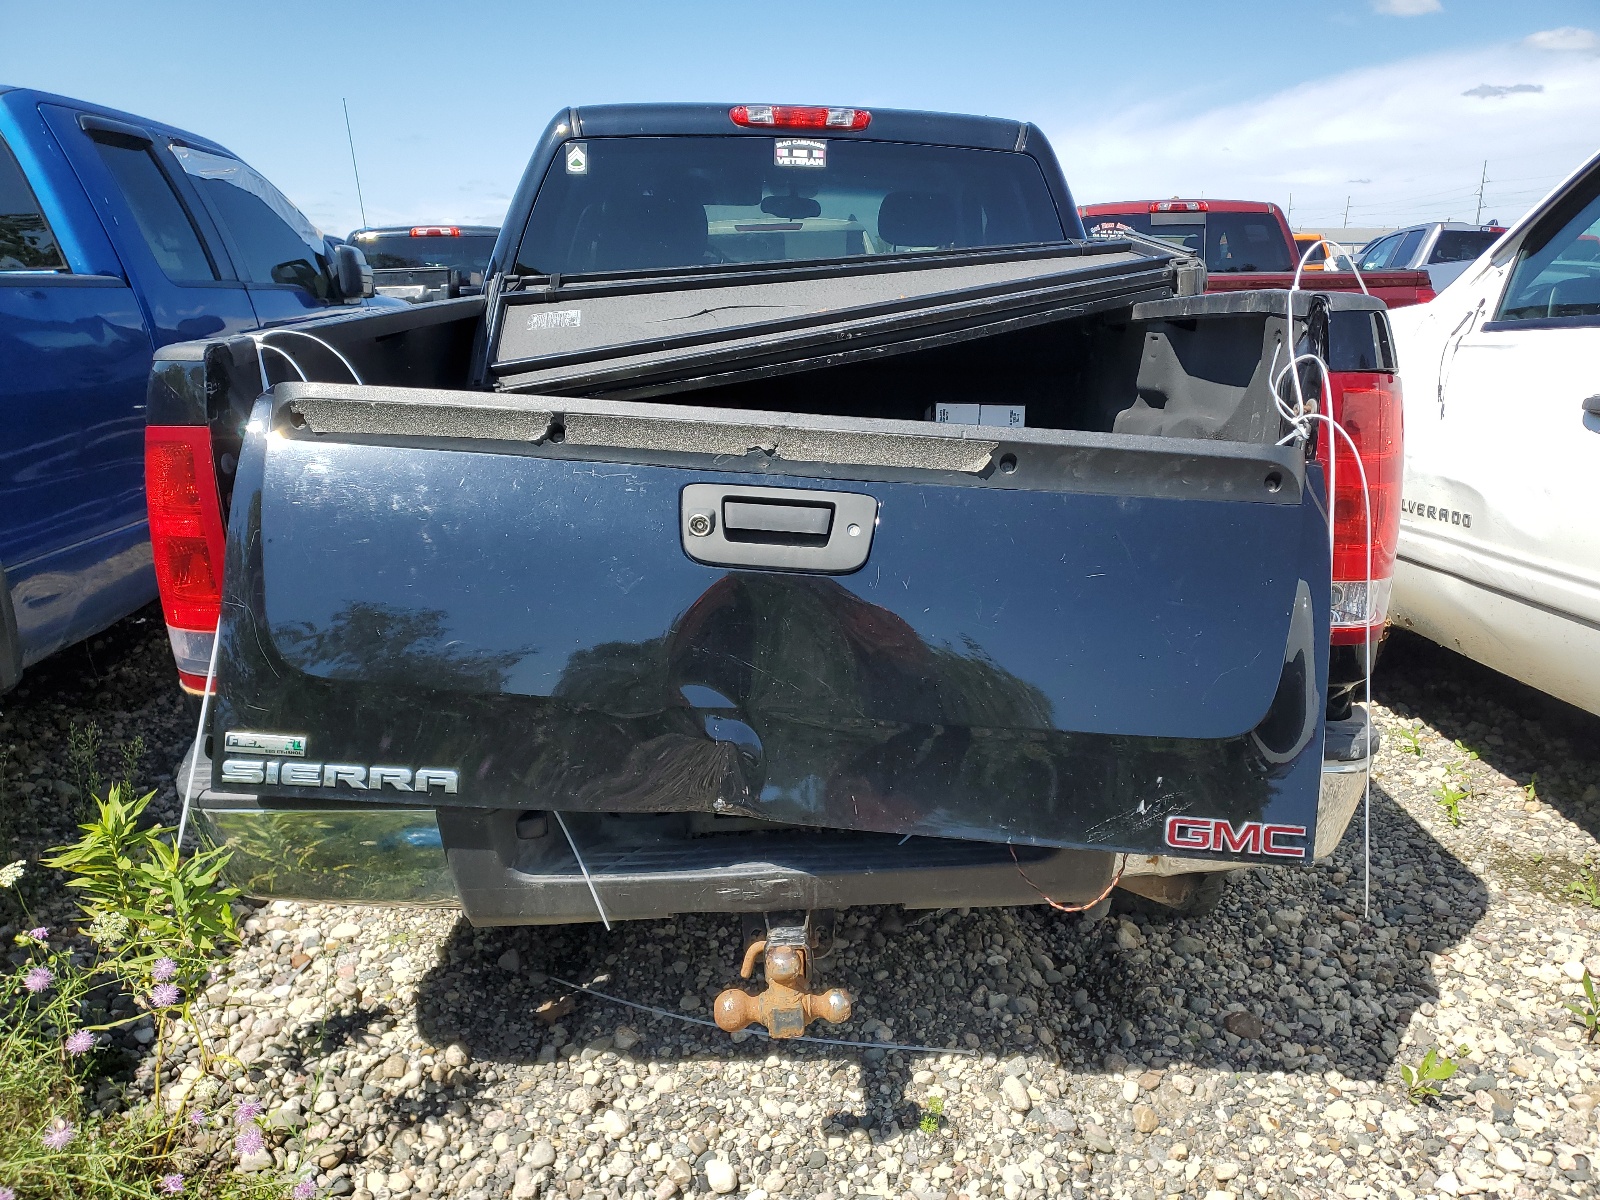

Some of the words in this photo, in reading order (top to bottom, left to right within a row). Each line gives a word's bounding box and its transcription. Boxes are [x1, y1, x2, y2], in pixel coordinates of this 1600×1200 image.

[792, 139, 826, 149] CAMPAIGN
[776, 157, 824, 166] VETERAN
[1401, 499, 1472, 528] LVERADO
[221, 759, 459, 794] SIERRA
[1165, 815, 1307, 858] GMC
